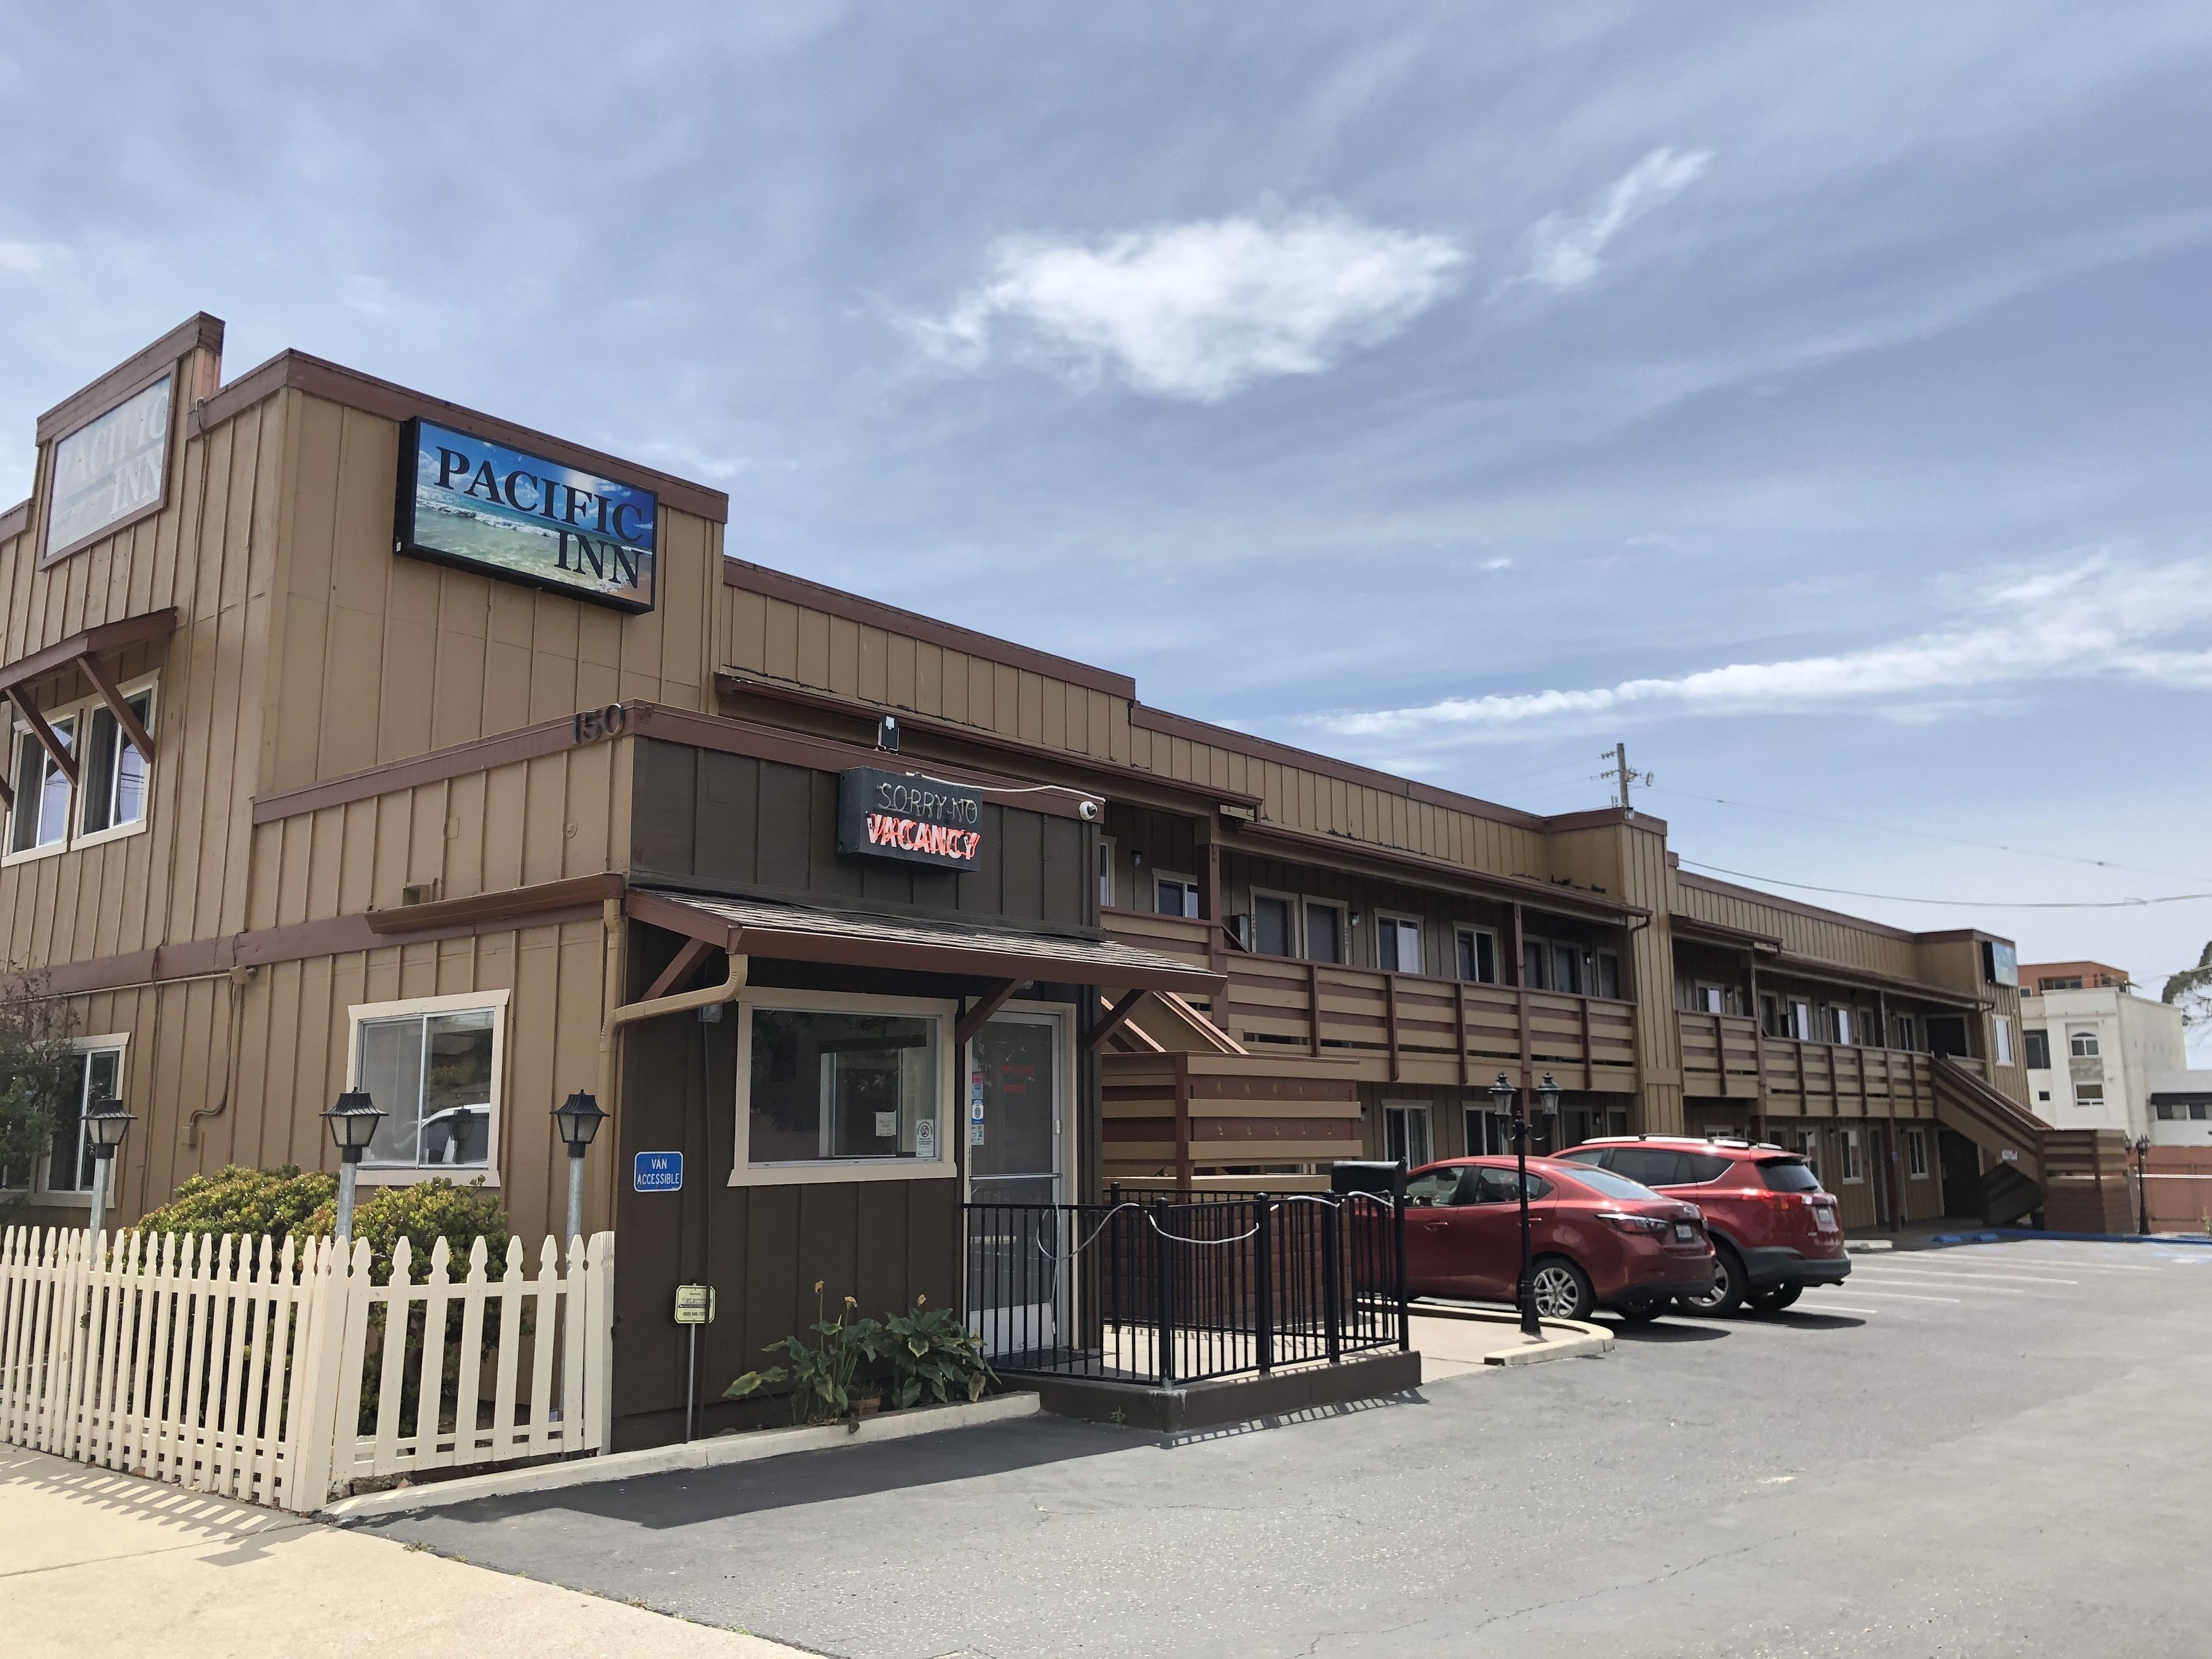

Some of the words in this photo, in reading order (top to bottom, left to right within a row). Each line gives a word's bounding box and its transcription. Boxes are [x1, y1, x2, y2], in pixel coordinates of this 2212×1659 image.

[110, 446, 164, 514] INN
[434, 445, 643, 542] PACIFIC
[554, 528, 643, 589] INN
[572, 703, 625, 746] 150
[877, 782, 947, 820] SORRY
[951, 797, 978, 824] NO
[866, 813, 980, 860] VACANCY
[637, 1173, 680, 1185] ACCESSIBLE
[651, 1158, 667, 1170] VAN
